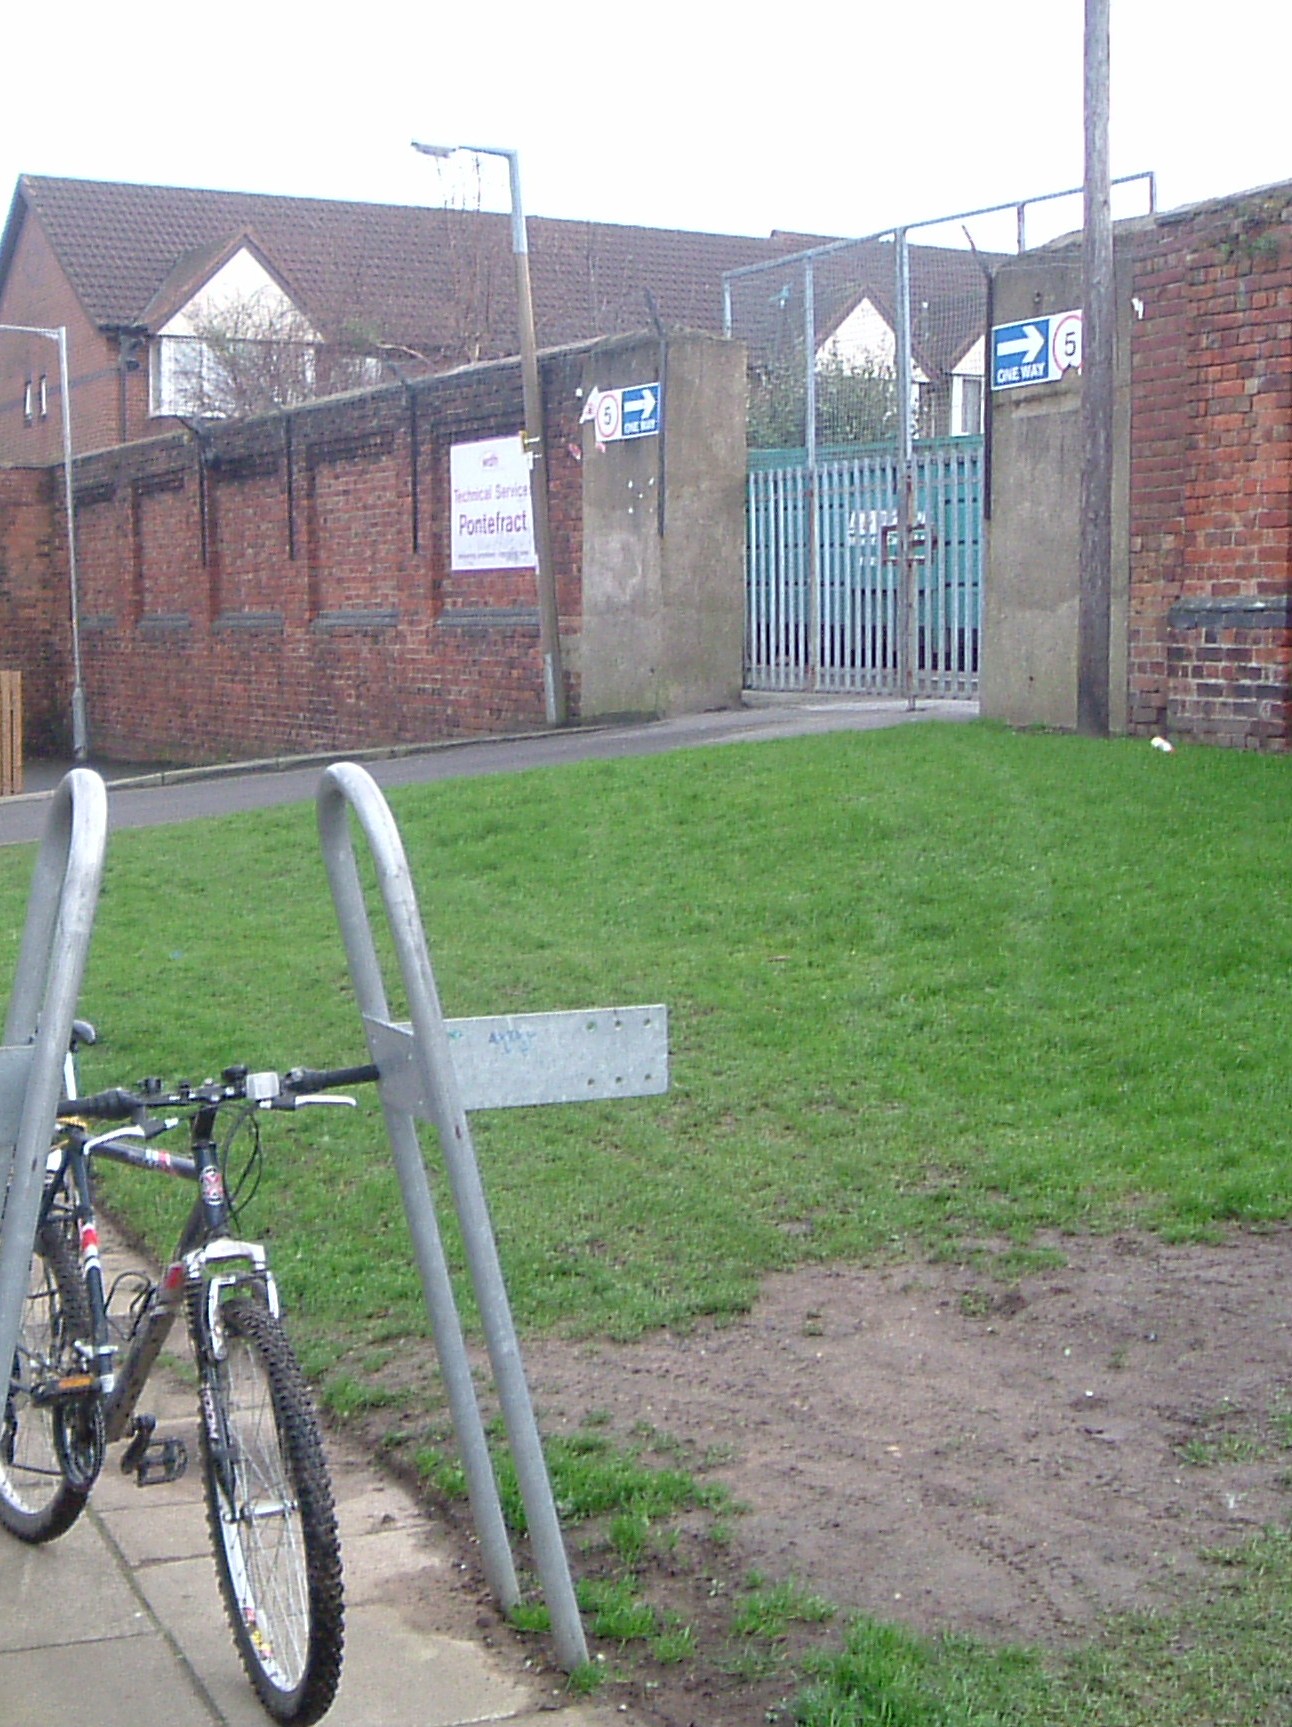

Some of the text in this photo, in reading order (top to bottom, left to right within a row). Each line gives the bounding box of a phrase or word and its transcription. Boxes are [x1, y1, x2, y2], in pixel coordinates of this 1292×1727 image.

[1065, 332, 1076, 356] 5
[997, 362, 1045, 383] ONE WAY
[604, 406, 612, 426] 5
[624, 421, 640, 435] ONE
[459, 511, 527, 536] Pontefract
